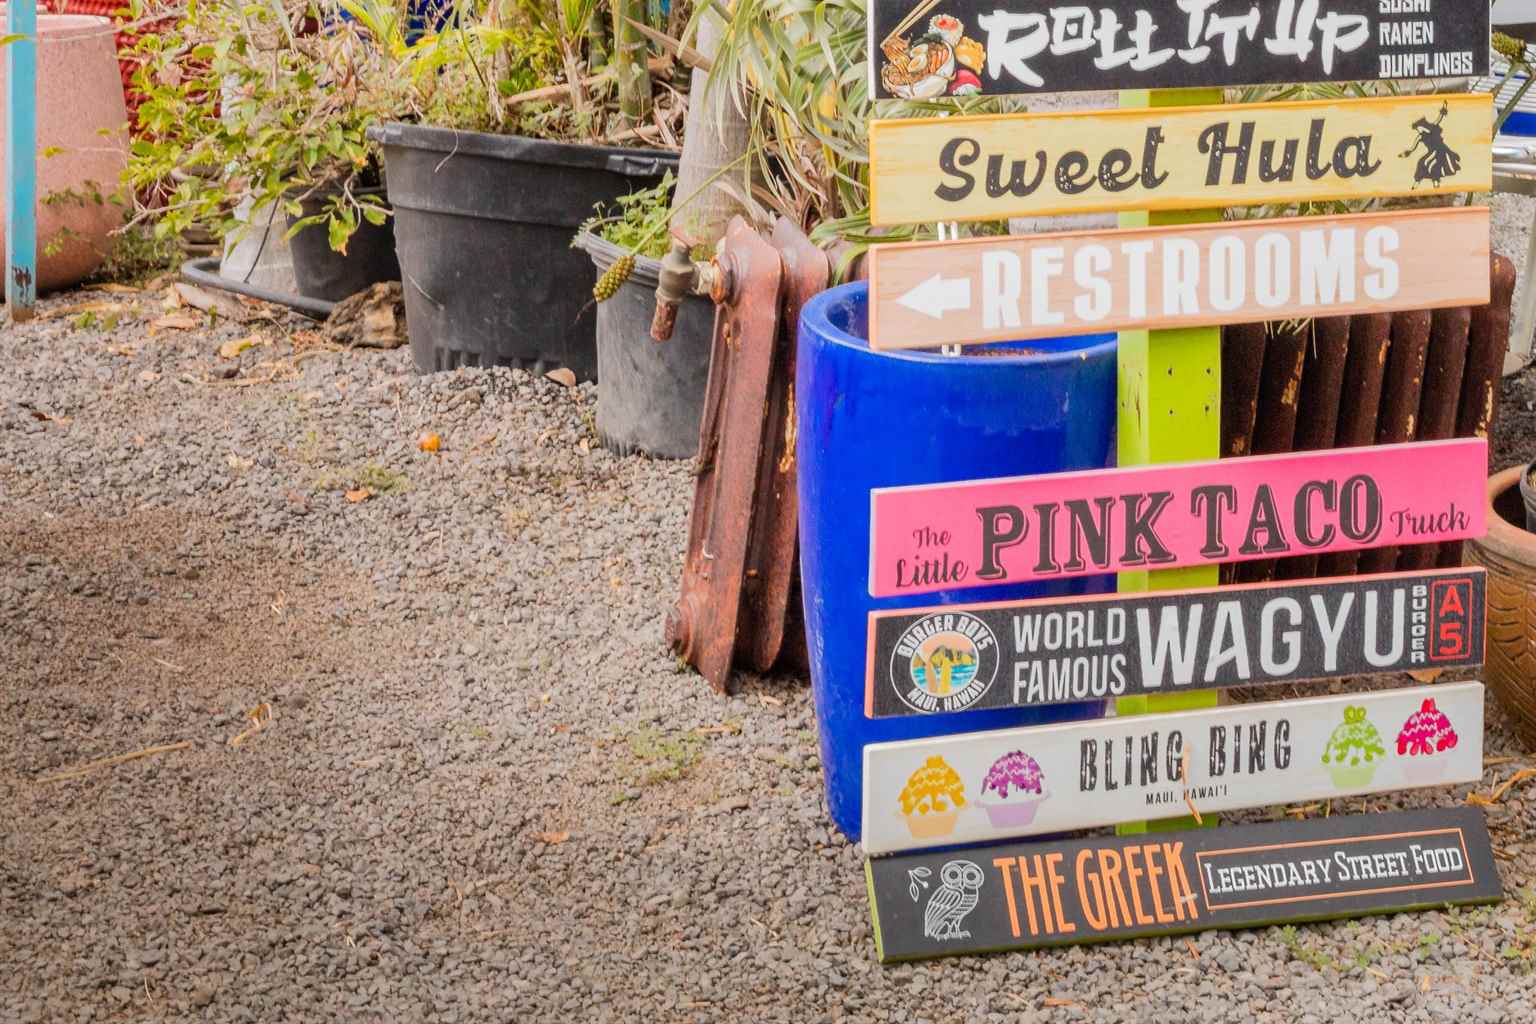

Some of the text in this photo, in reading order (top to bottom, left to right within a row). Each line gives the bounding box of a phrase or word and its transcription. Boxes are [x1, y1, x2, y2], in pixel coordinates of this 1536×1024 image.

[1379, 21, 1434, 46] RAMEN
[1379, 51, 1473, 78] DUMPLINGS
[934, 118, 1381, 202] Sweet Hula
[980, 225, 1400, 330] RESTROOMS
[912, 526, 951, 549] The
[975, 473, 1383, 580] PINK TACO
[1389, 503, 1471, 538] Truck
[895, 553, 968, 589] Little
[897, 614, 993, 658] BURGER BOYS
[1013, 607, 1125, 653] WORLD
[1136, 588, 1404, 688] WAGYU
[1411, 585, 1427, 663] BURGER
[1439, 585, 1464, 654] A5
[943, 679, 985, 711] HAWAII
[1012, 653, 1126, 705] FAMOUS
[1080, 718, 1291, 792] BLING BING
[993, 841, 1199, 938] THE GREEK
[1204, 844, 1464, 895] LEGENDARY STREET FOOD
